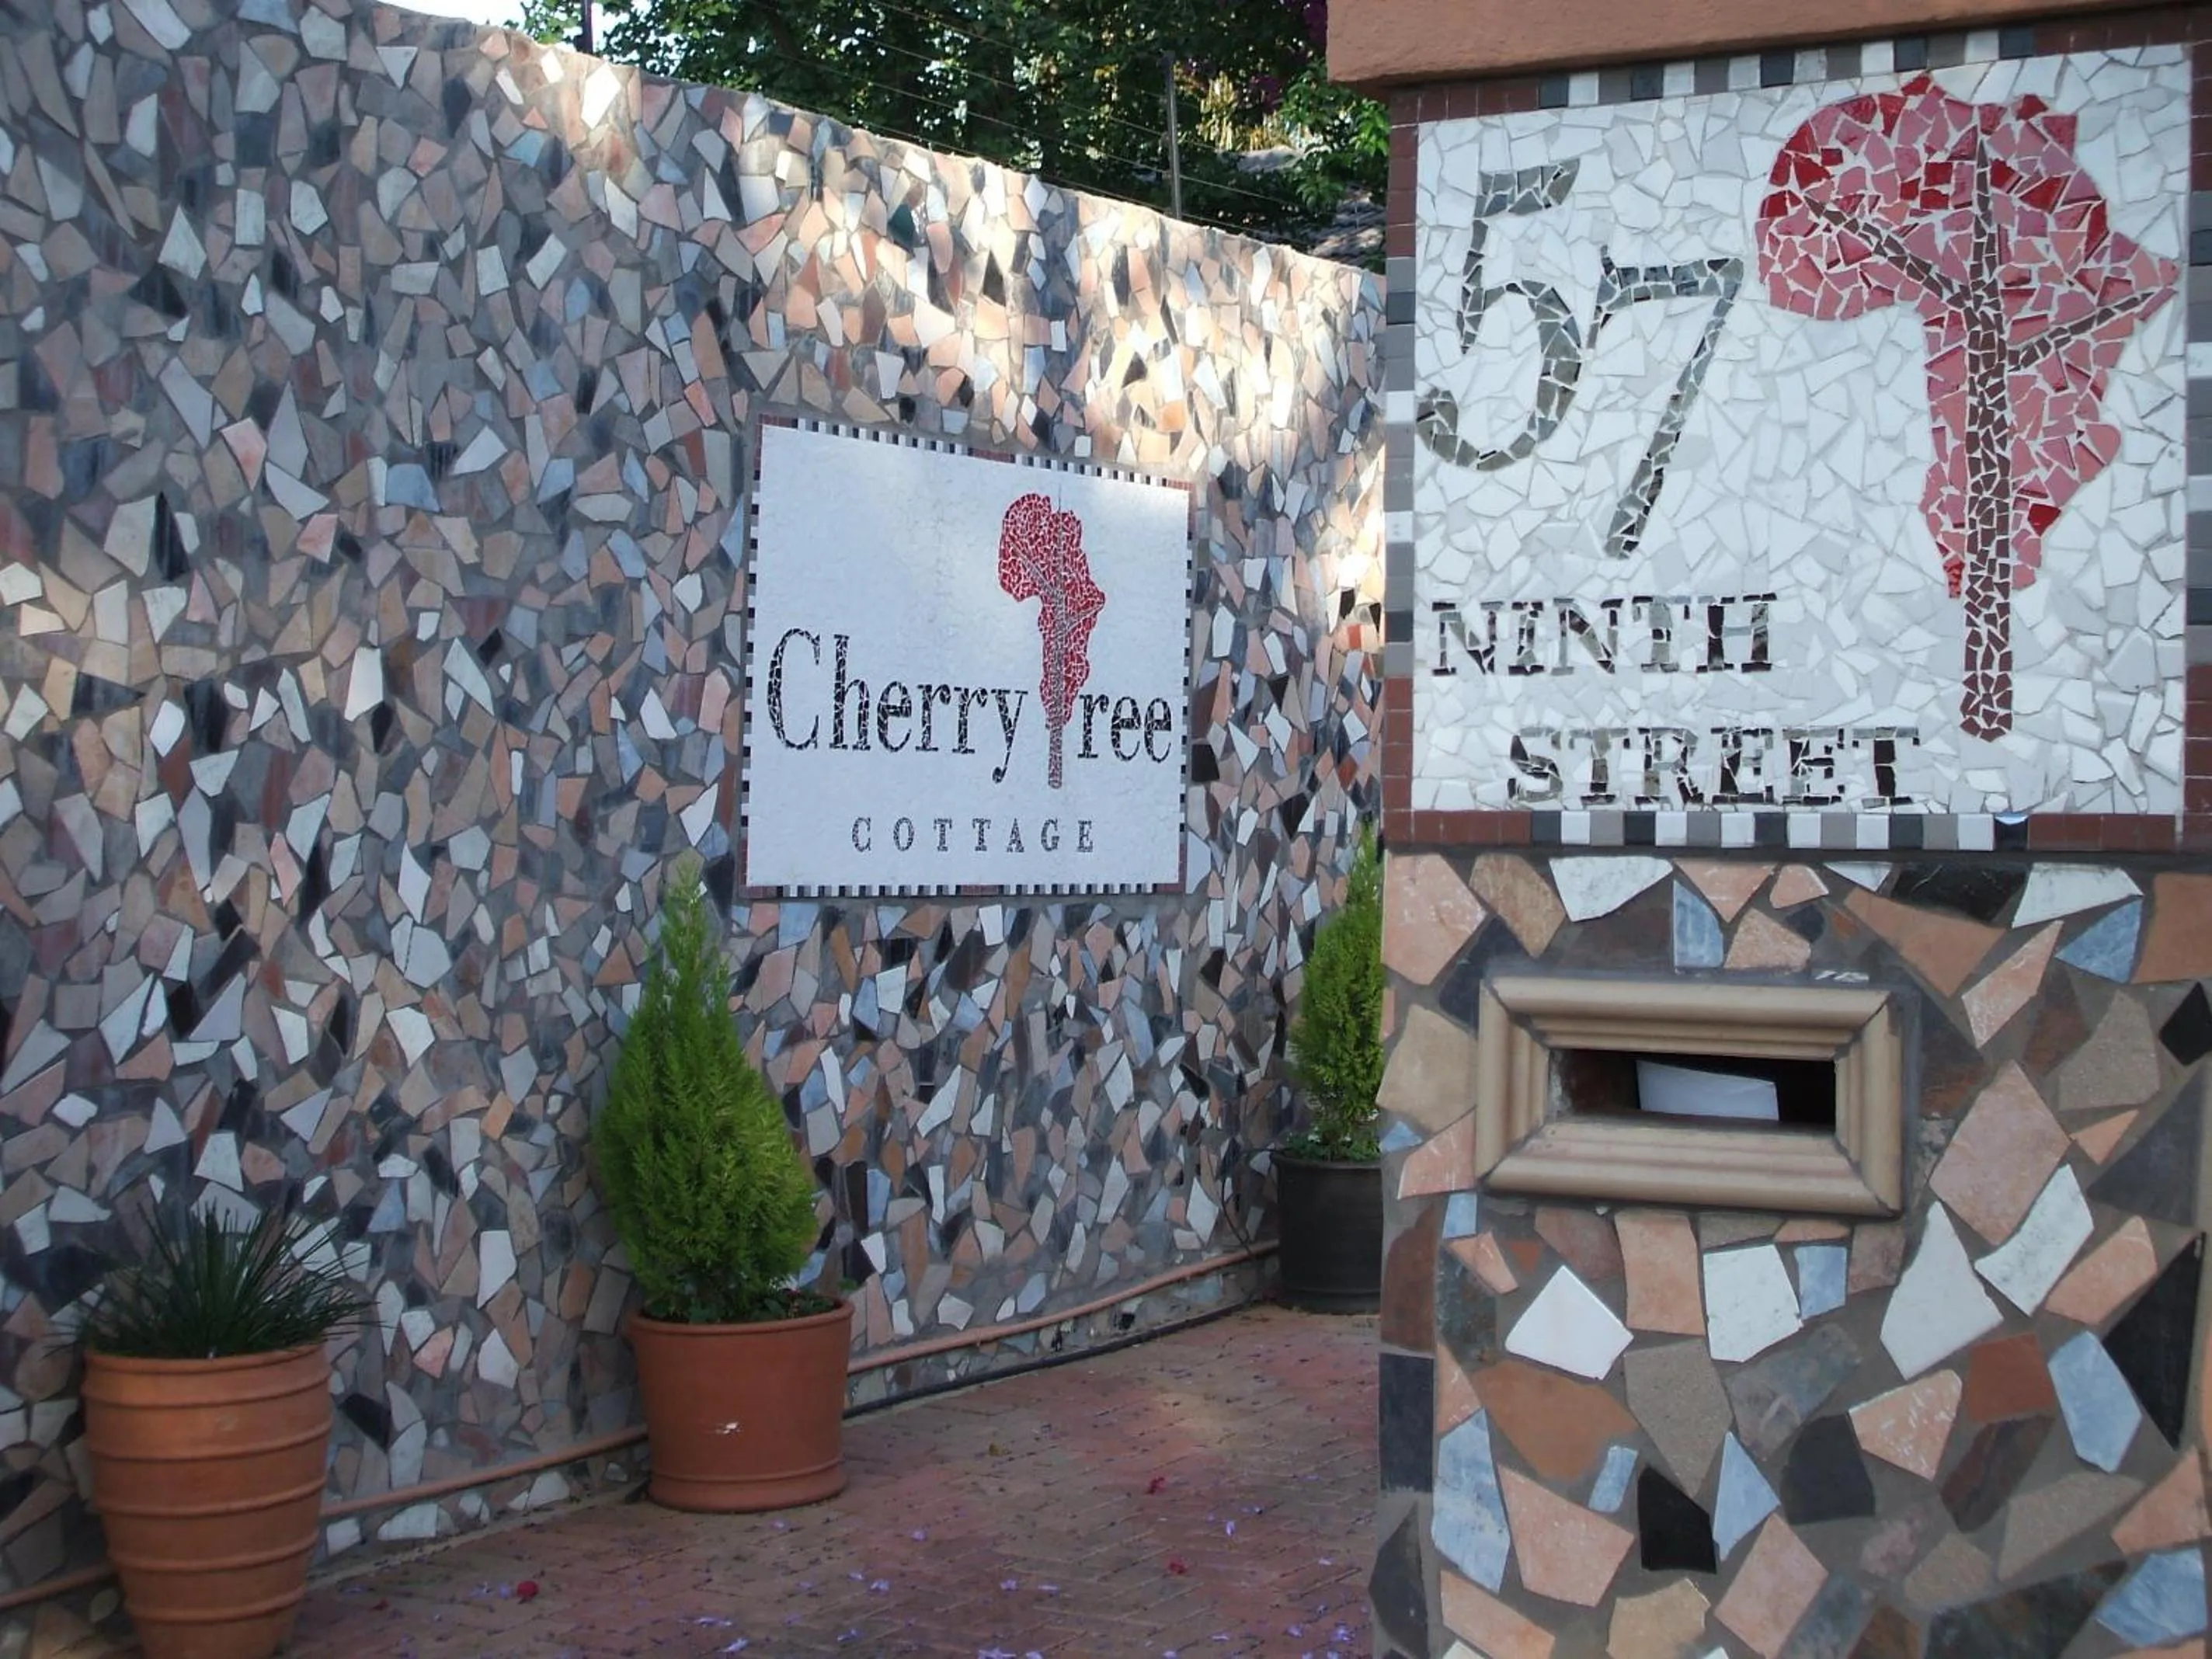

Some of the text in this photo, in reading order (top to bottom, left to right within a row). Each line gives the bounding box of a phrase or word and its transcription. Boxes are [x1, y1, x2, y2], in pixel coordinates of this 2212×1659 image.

[1415, 158, 1744, 559] 57
[1431, 592, 1778, 676] NINTH
[767, 627, 1028, 784] Cherry
[1508, 726, 1921, 806] STREET
[850, 816, 1094, 854] COTTAGE
